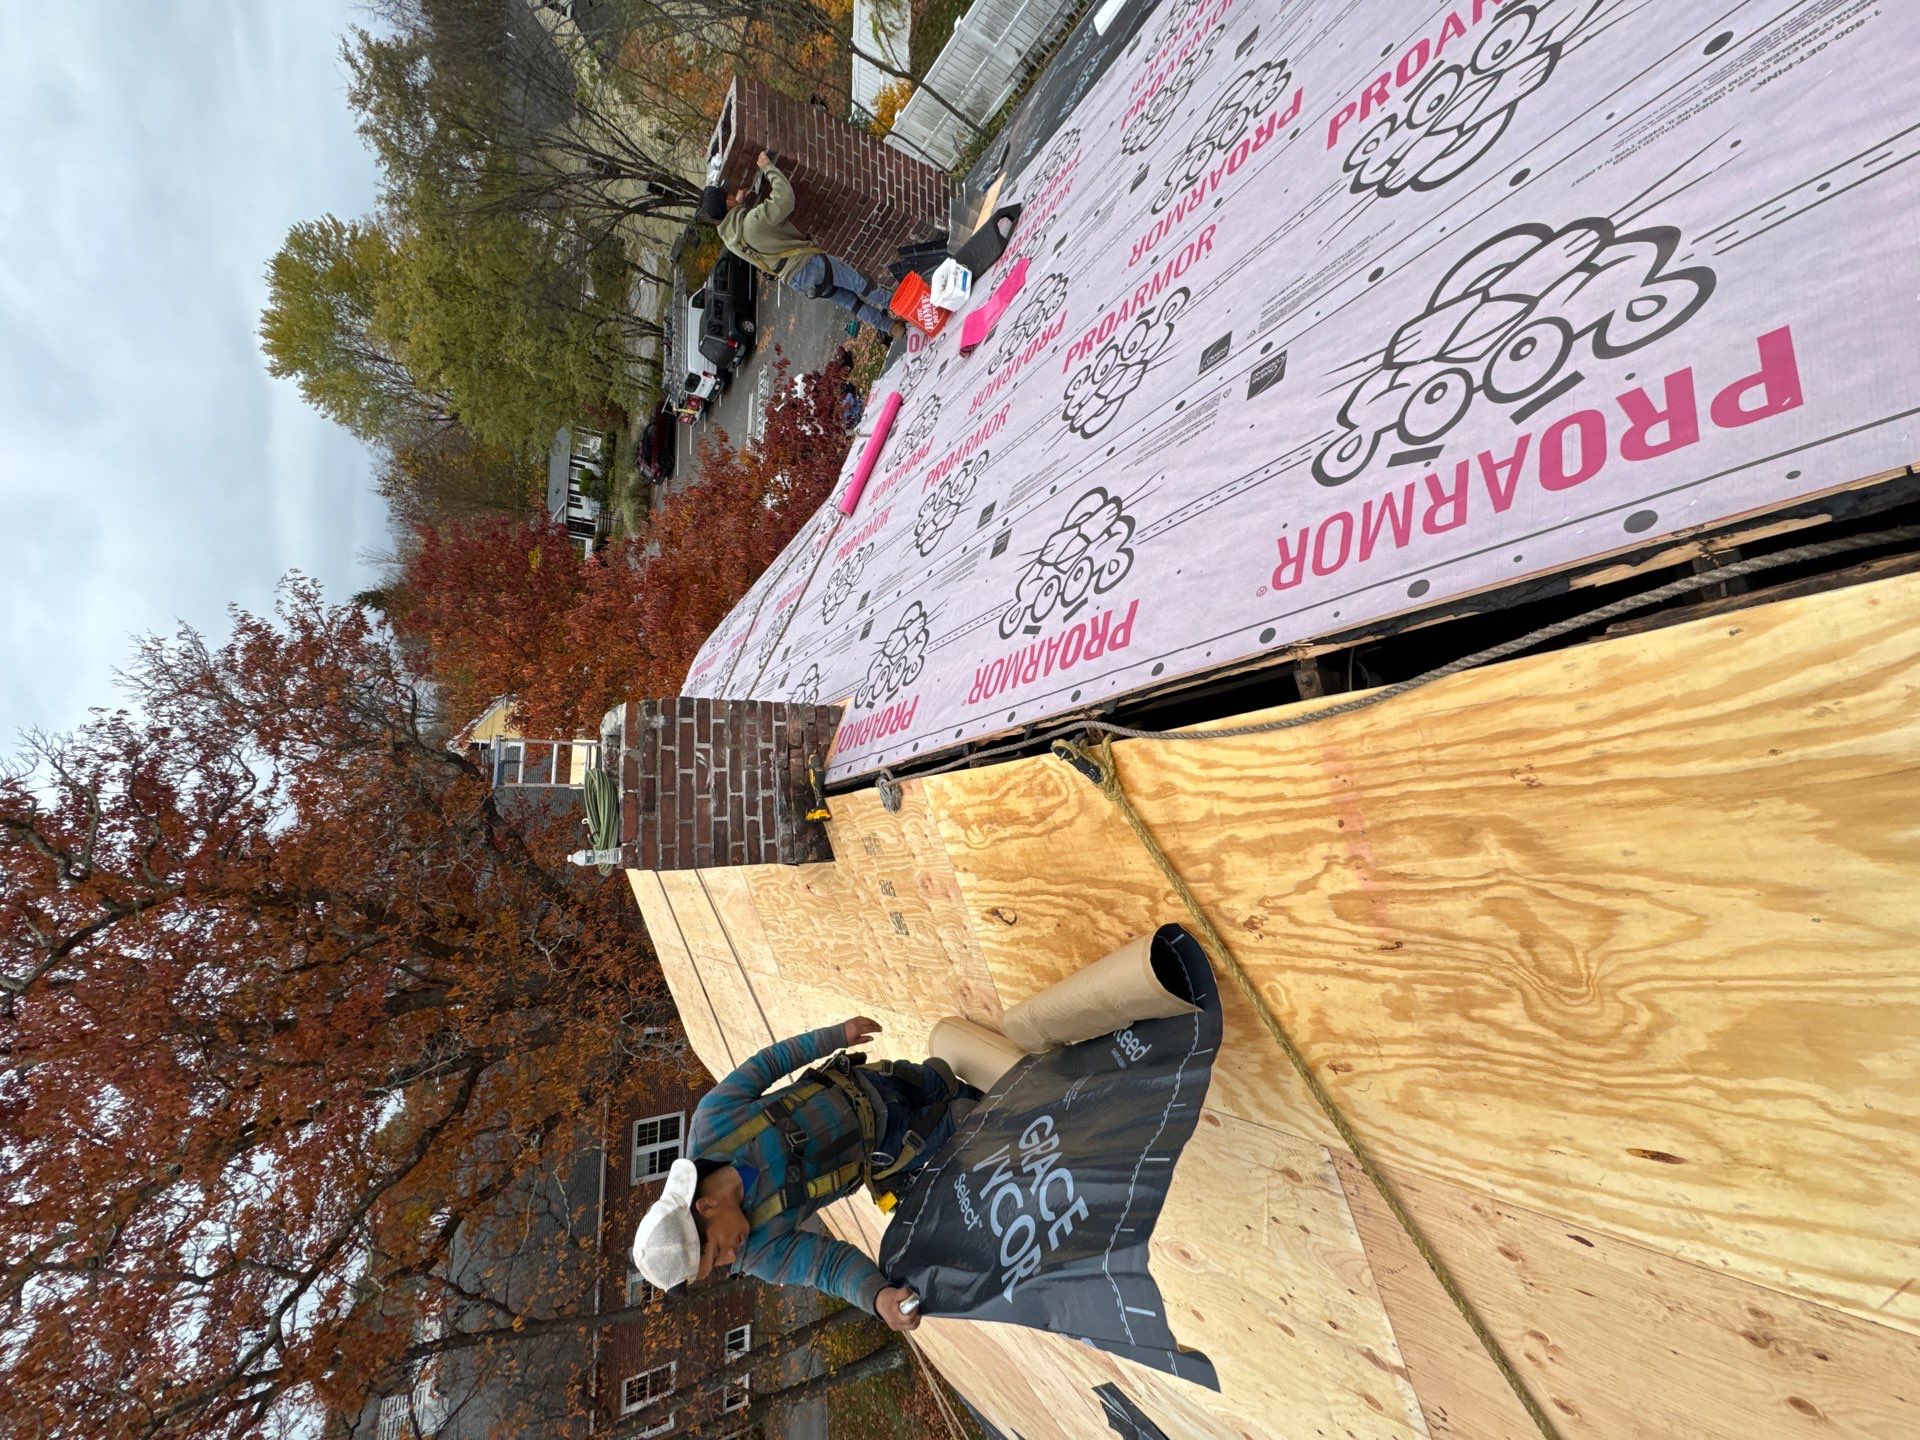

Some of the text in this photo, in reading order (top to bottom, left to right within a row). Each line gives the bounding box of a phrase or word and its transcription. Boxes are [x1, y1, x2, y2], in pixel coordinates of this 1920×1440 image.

[1120, 0, 1233, 132] PROARMO
[1128, 87, 1303, 267] PROARMOR
[968, 310, 1067, 415] PROARMOR
[1062, 224, 1217, 375] PROARMOR
[921, 404, 1011, 494] PROARMOR
[1271, 325, 1804, 591] PROARMOR
[967, 599, 1140, 705] PROARMOR
[953, 1172, 980, 1232] Select
[972, 1143, 1042, 1304] VYCOR
[1018, 1114, 1079, 1252] GRACE
